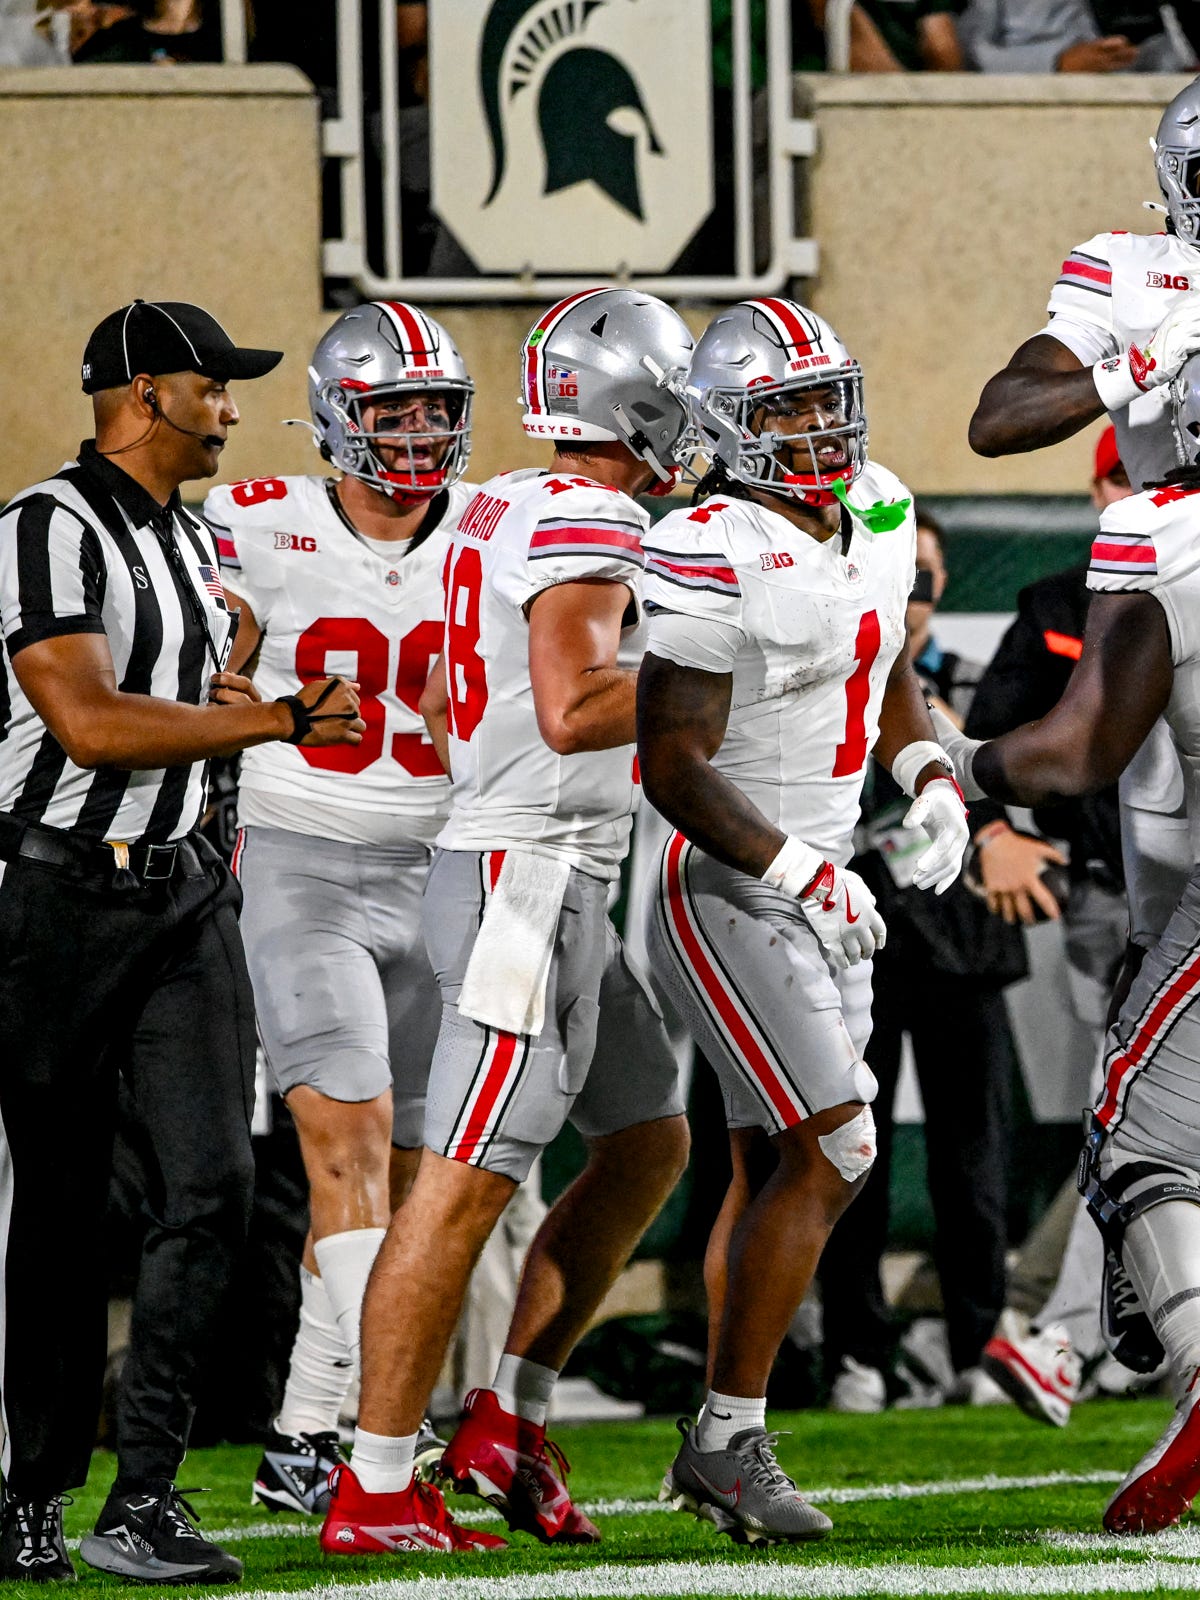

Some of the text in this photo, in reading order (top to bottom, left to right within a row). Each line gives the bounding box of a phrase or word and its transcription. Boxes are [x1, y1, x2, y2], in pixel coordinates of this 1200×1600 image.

[547, 368, 557, 379] 18
[790, 354, 832, 372] OHIO STATE
[132, 565, 149, 590] S
[831, 609, 881, 778] 1
[131, 1531, 155, 1555] GOE-TEX
